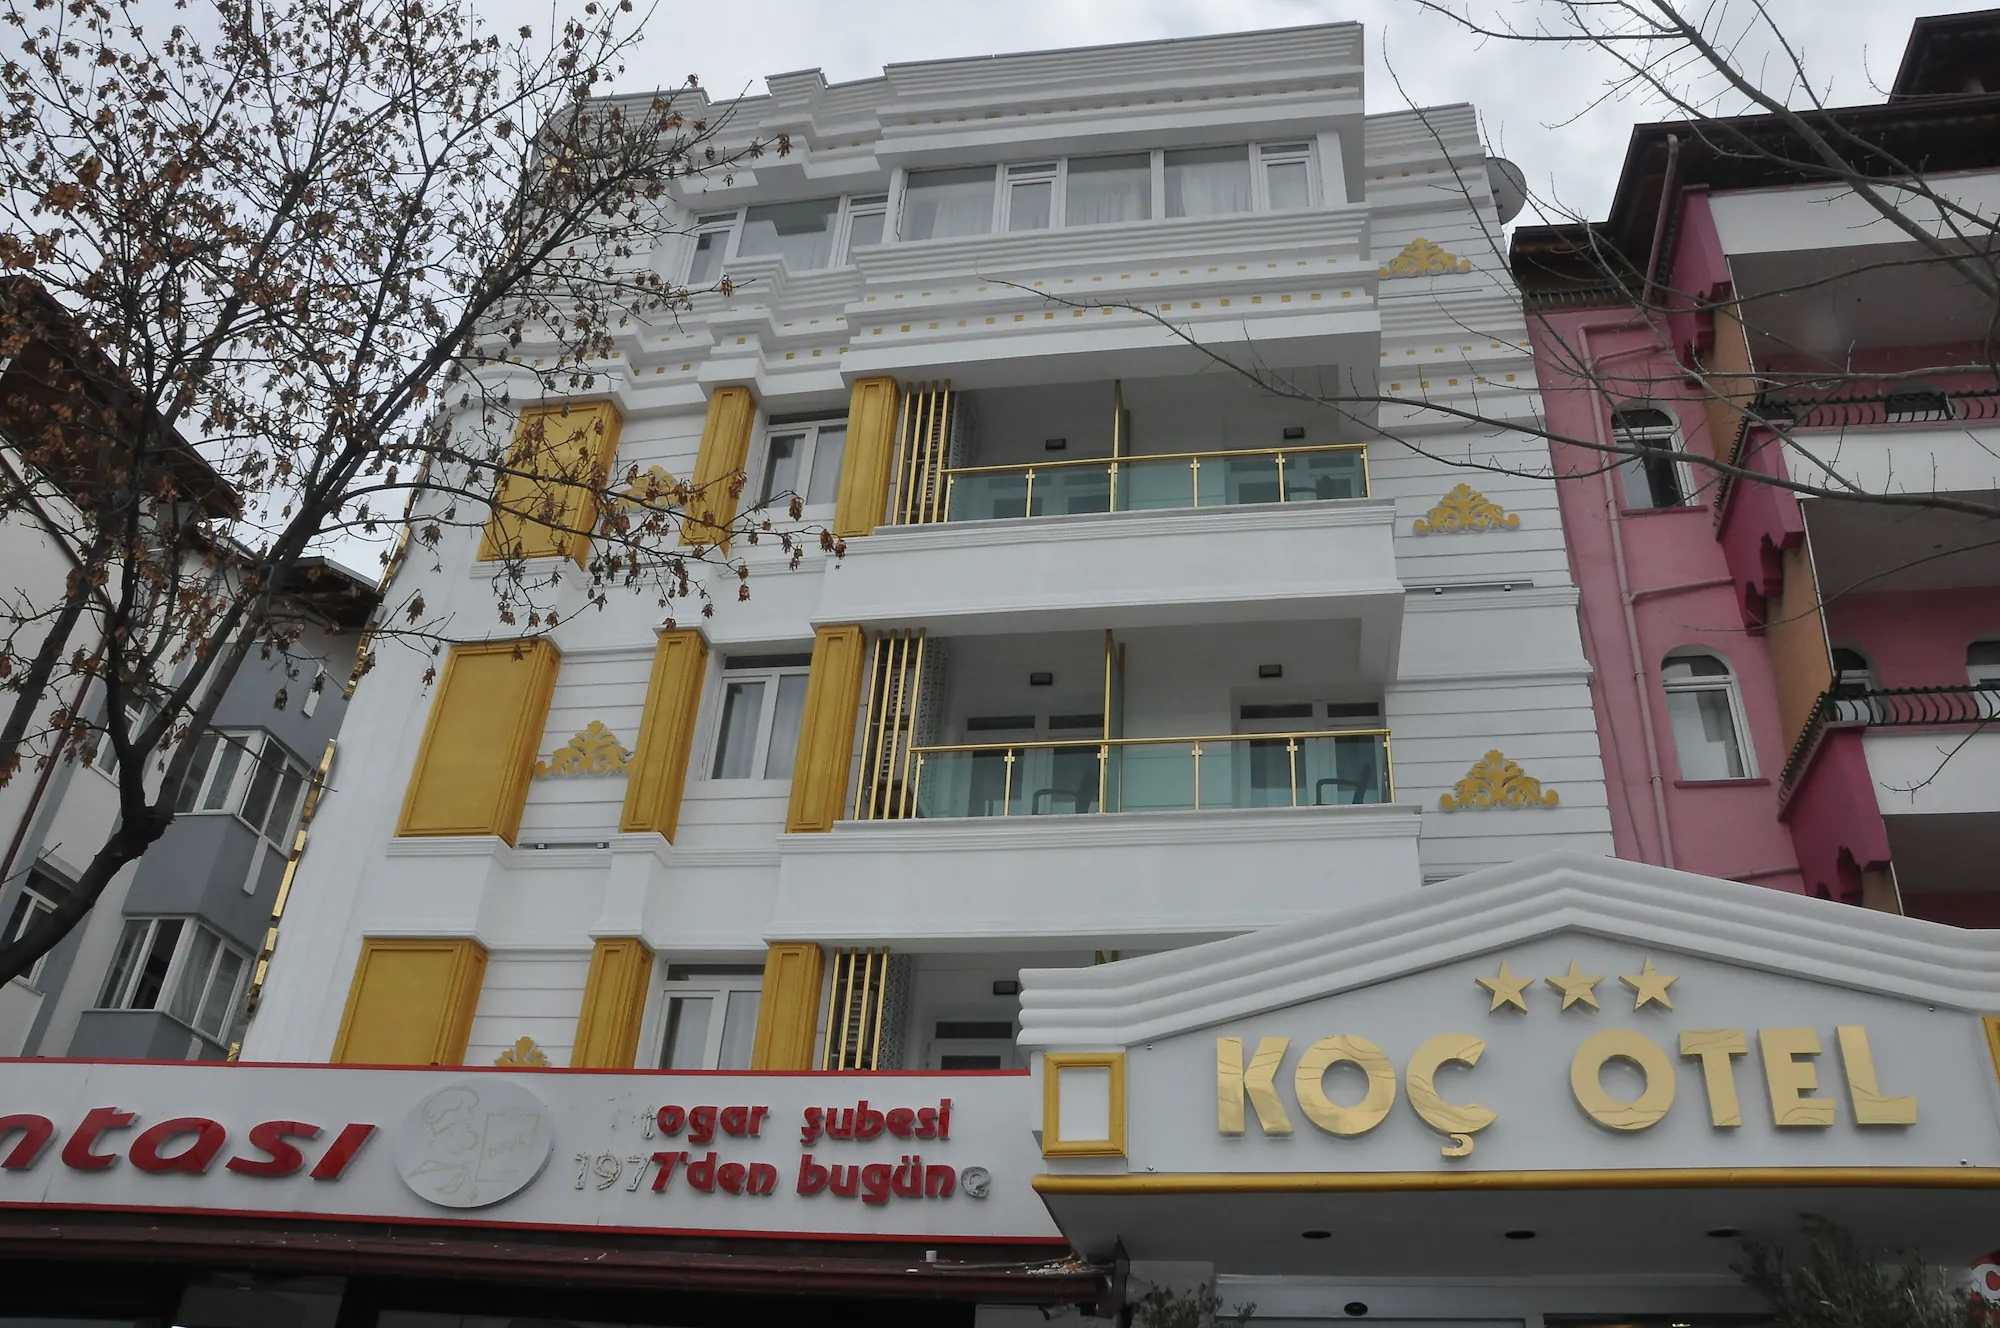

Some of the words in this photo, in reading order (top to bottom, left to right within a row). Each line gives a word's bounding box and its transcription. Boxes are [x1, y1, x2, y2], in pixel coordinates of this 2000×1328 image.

[1216, 1033, 1498, 1158] KOÇ
[1570, 1026, 1918, 1131] OTEL
[800, 1098, 954, 1147] şubesi
[796, 1154, 991, 1206] bugüne
